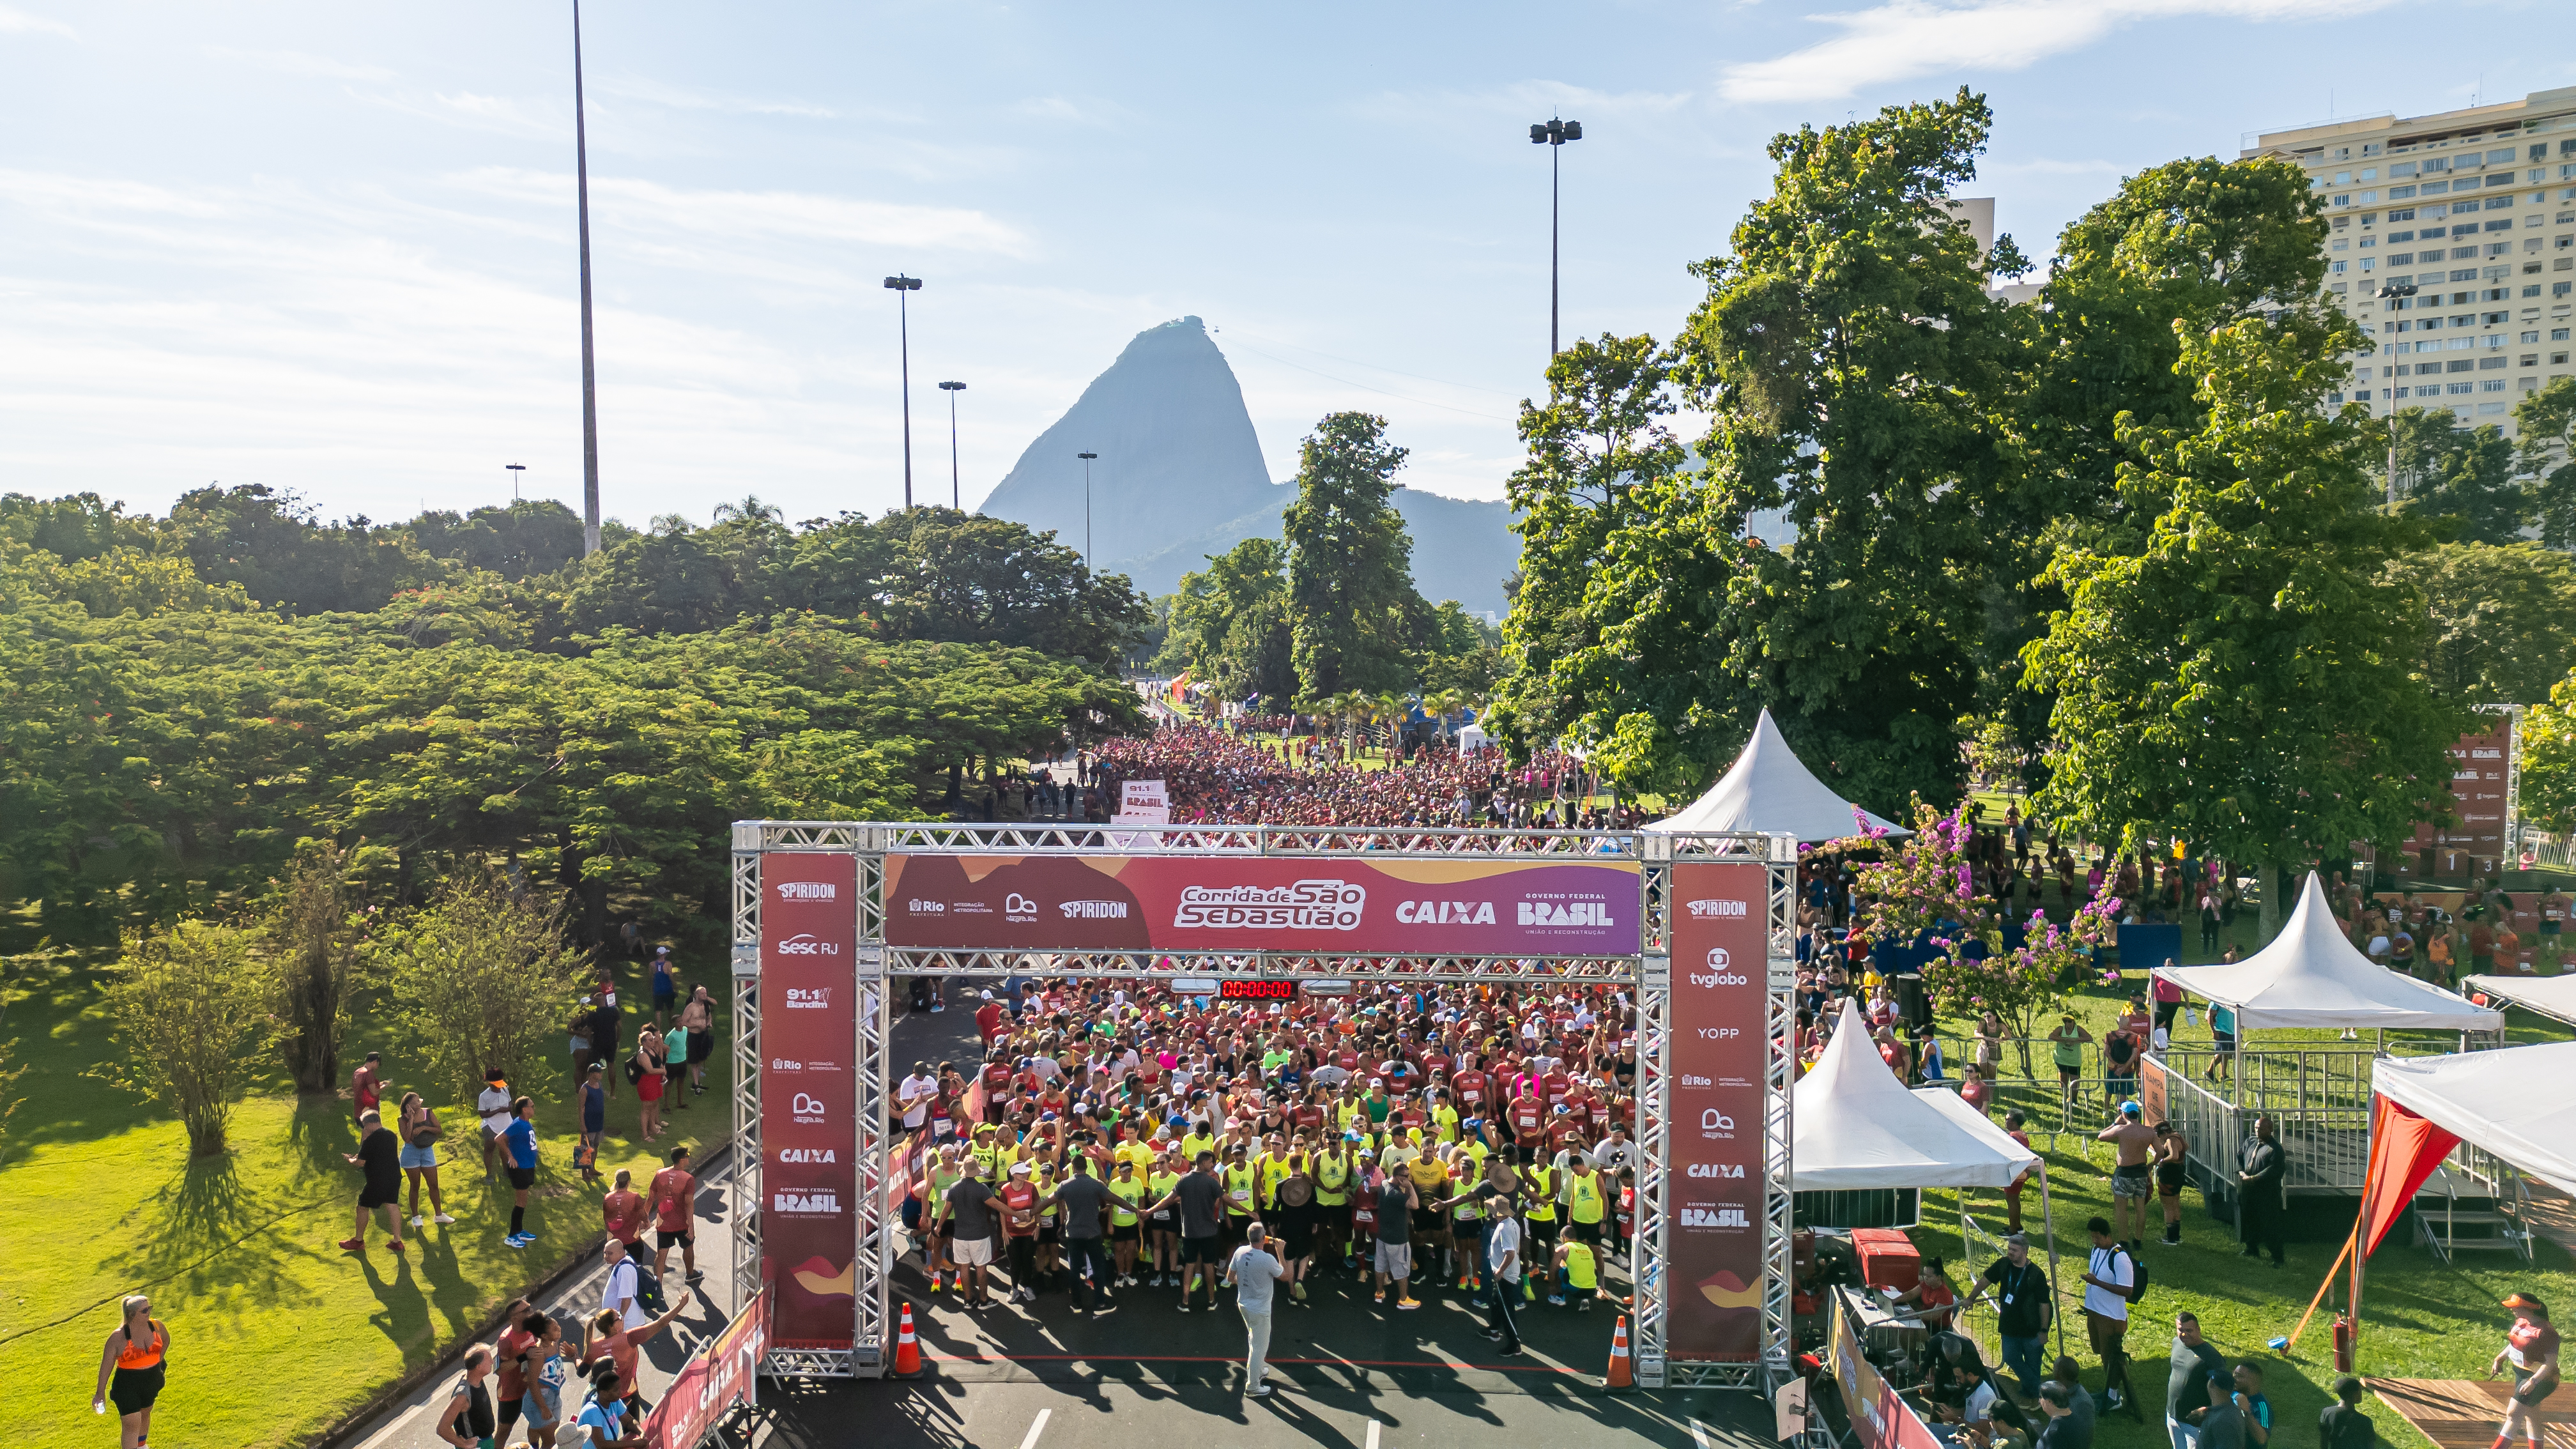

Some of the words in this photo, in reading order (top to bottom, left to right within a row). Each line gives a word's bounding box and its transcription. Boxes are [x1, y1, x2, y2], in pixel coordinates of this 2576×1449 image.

[1127, 797, 1163, 808] BRASIL
[2449, 853, 2455, 870] 1
[2485, 860, 2492, 872] 3
[781, 884, 836, 898] SPIRIDON
[1184, 888, 1263, 903] Corrida
[1267, 889, 1290, 903] de
[1294, 883, 1361, 904] São
[923, 900, 945, 912] Rio
[1064, 901, 1128, 919] SPIRIDON
[1395, 901, 1496, 925] CAIXA
[1517, 901, 1614, 926] BRASIL
[1691, 901, 1747, 916] SPIRIDON
[1181, 905, 1357, 925] Sebastião
[821, 942, 838, 955] RJ
[1690, 972, 1747, 988] tvglobo
[786, 988, 820, 1000] 91.1
[1223, 981, 1291, 997] 00:00:00
[1698, 1028, 1740, 1039] YOPP
[784, 1060, 802, 1070] Rio
[1693, 1076, 1712, 1086] Rio
[2146, 1071, 2164, 1091] RAMPA
[2152, 1091, 2158, 1102] DE
[2147, 1101, 2164, 1121] ACESSO
[779, 1149, 836, 1163] CAIXA
[1687, 1163, 1745, 1178] CAIXA
[774, 1194, 841, 1213] BRASIL
[1681, 1209, 1750, 1227] BRASIL
[700, 1360, 733, 1411] CAIXA
